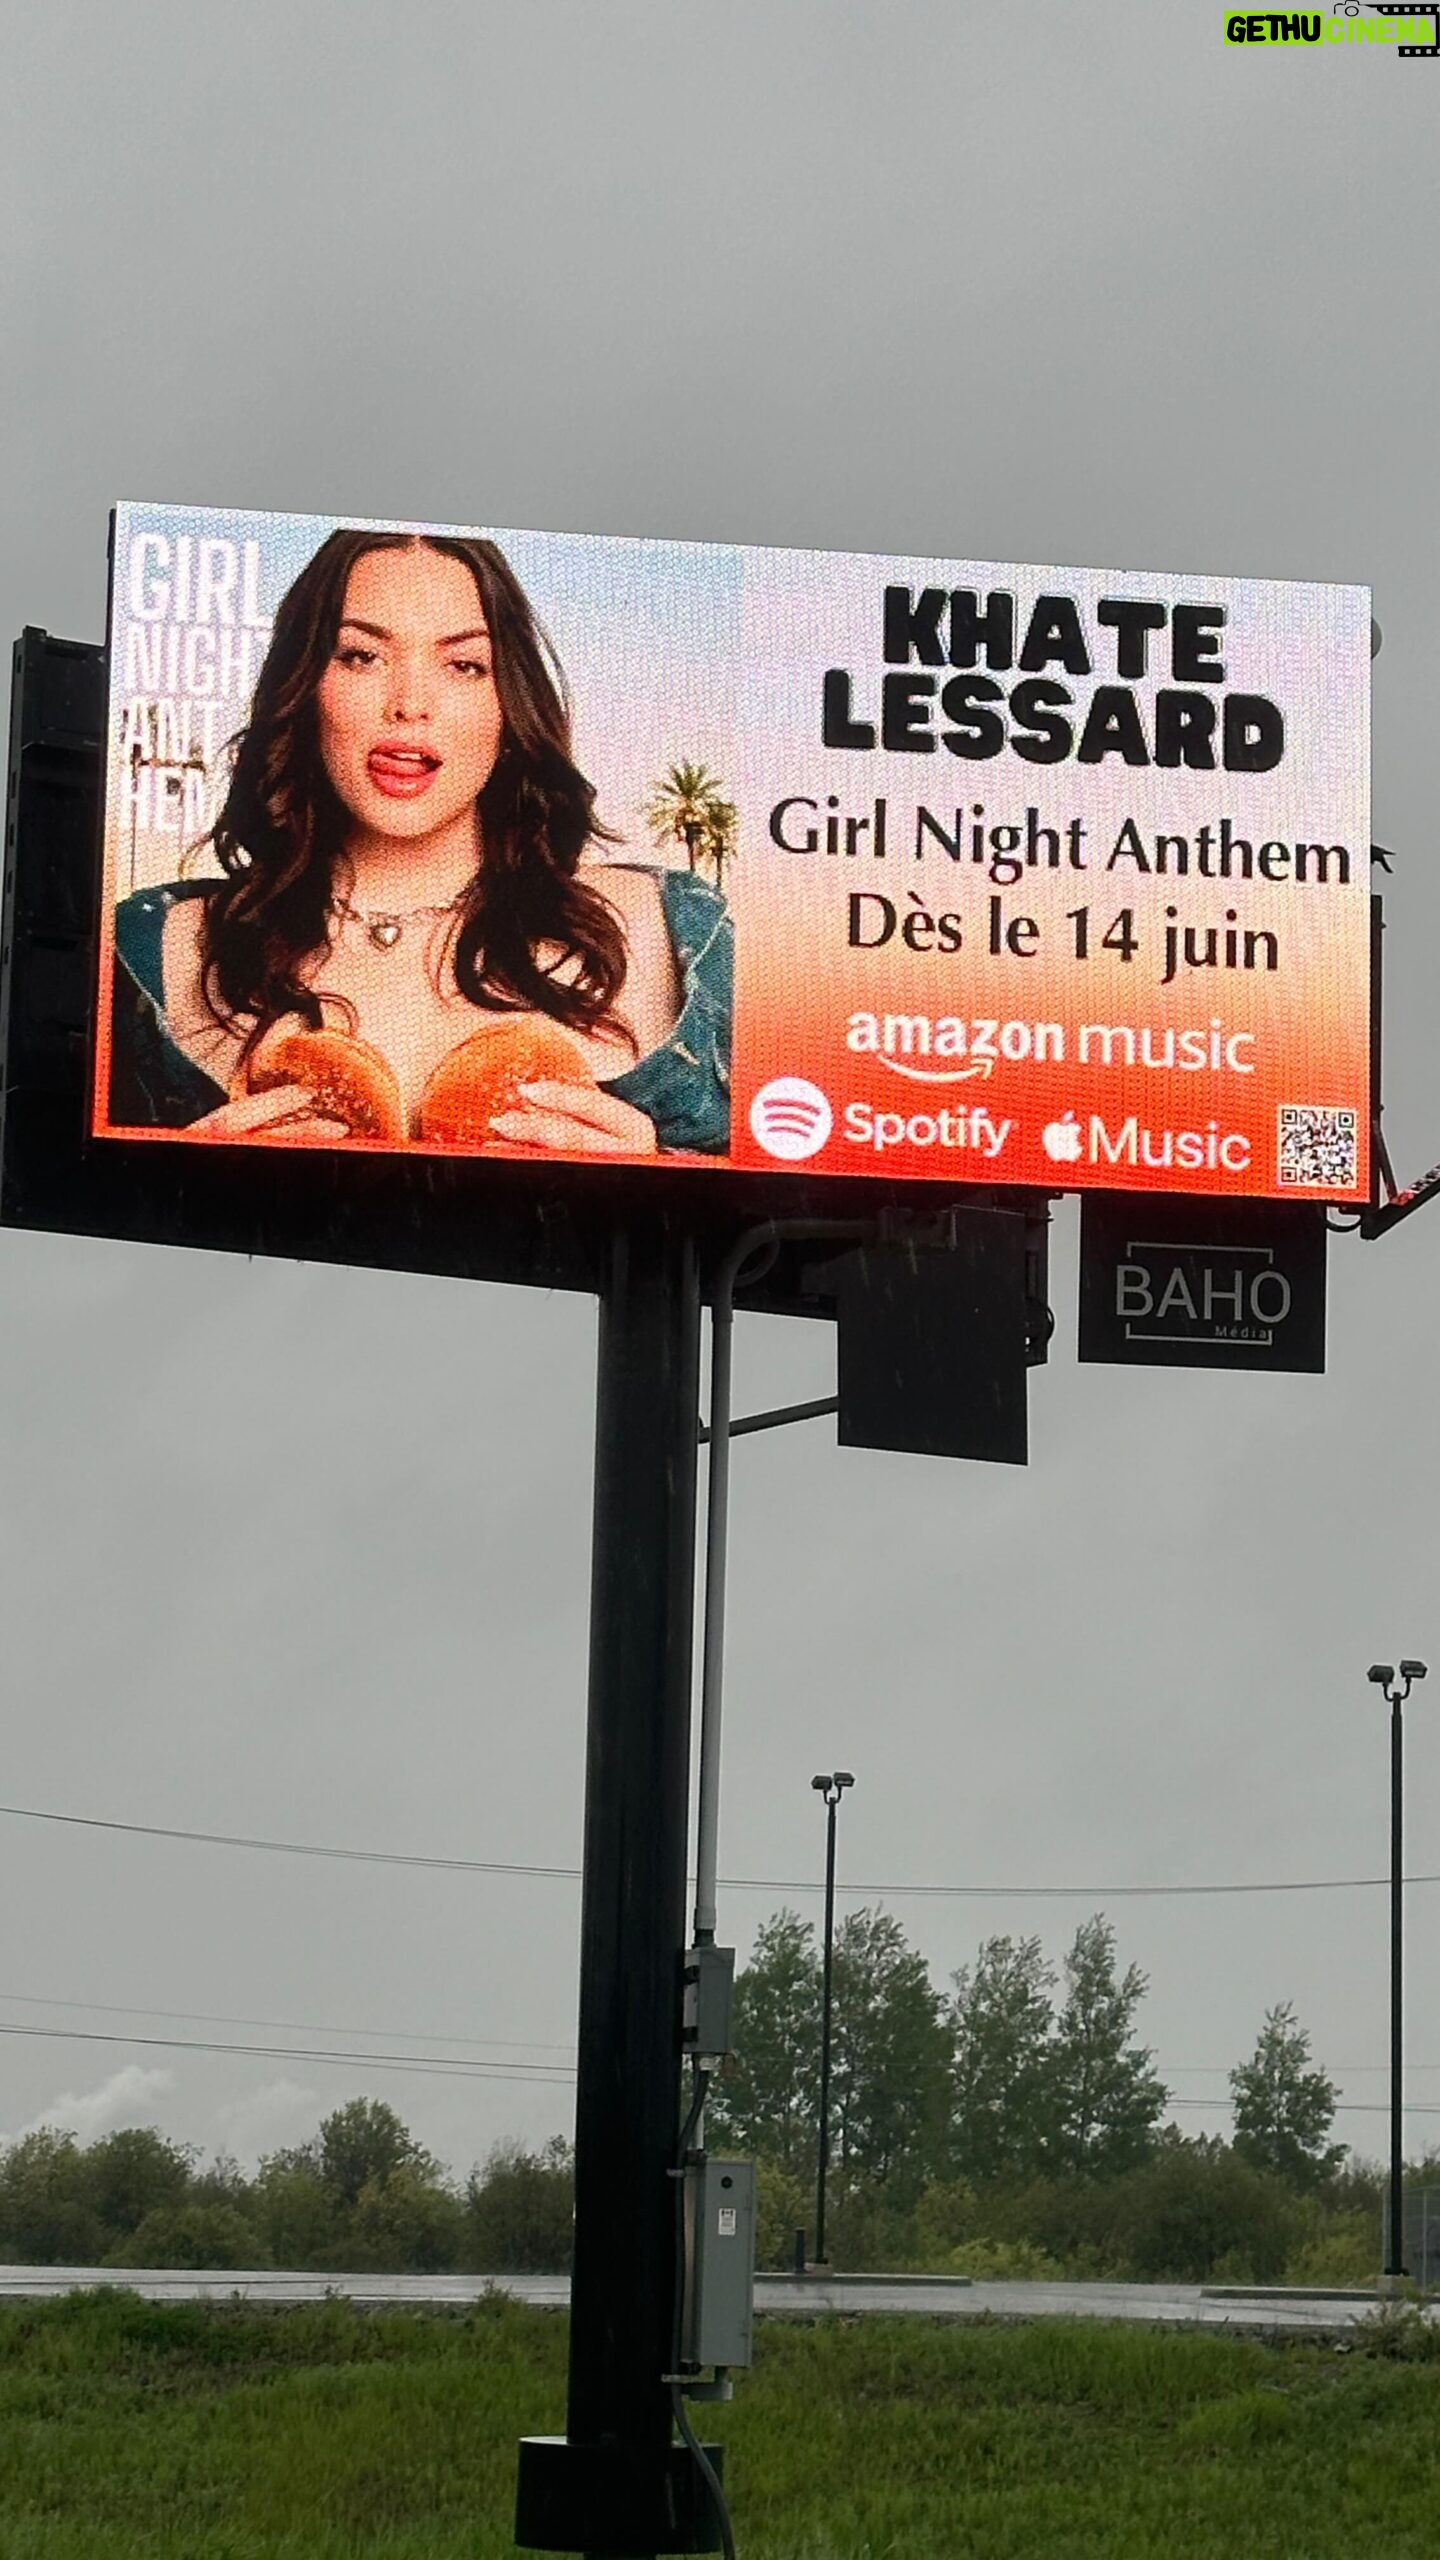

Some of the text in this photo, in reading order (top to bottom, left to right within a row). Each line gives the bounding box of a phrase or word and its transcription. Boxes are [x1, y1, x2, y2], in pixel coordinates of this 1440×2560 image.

[129, 532, 273, 628] GIRL
[884, 585, 1227, 683] KHATE
[822, 668, 1285, 773] LESSARD
[769, 797, 1351, 885] Girl Night Anthem
[848, 890, 1279, 985] Dès le 14 juin
[847, 1010, 1255, 1073] amazon music
[844, 1102, 1012, 1158] Spotify
[1089, 1117, 1251, 1171] Music
[1116, 1265, 1291, 1323] BAHO
[1215, 1325, 1268, 1339] Média
